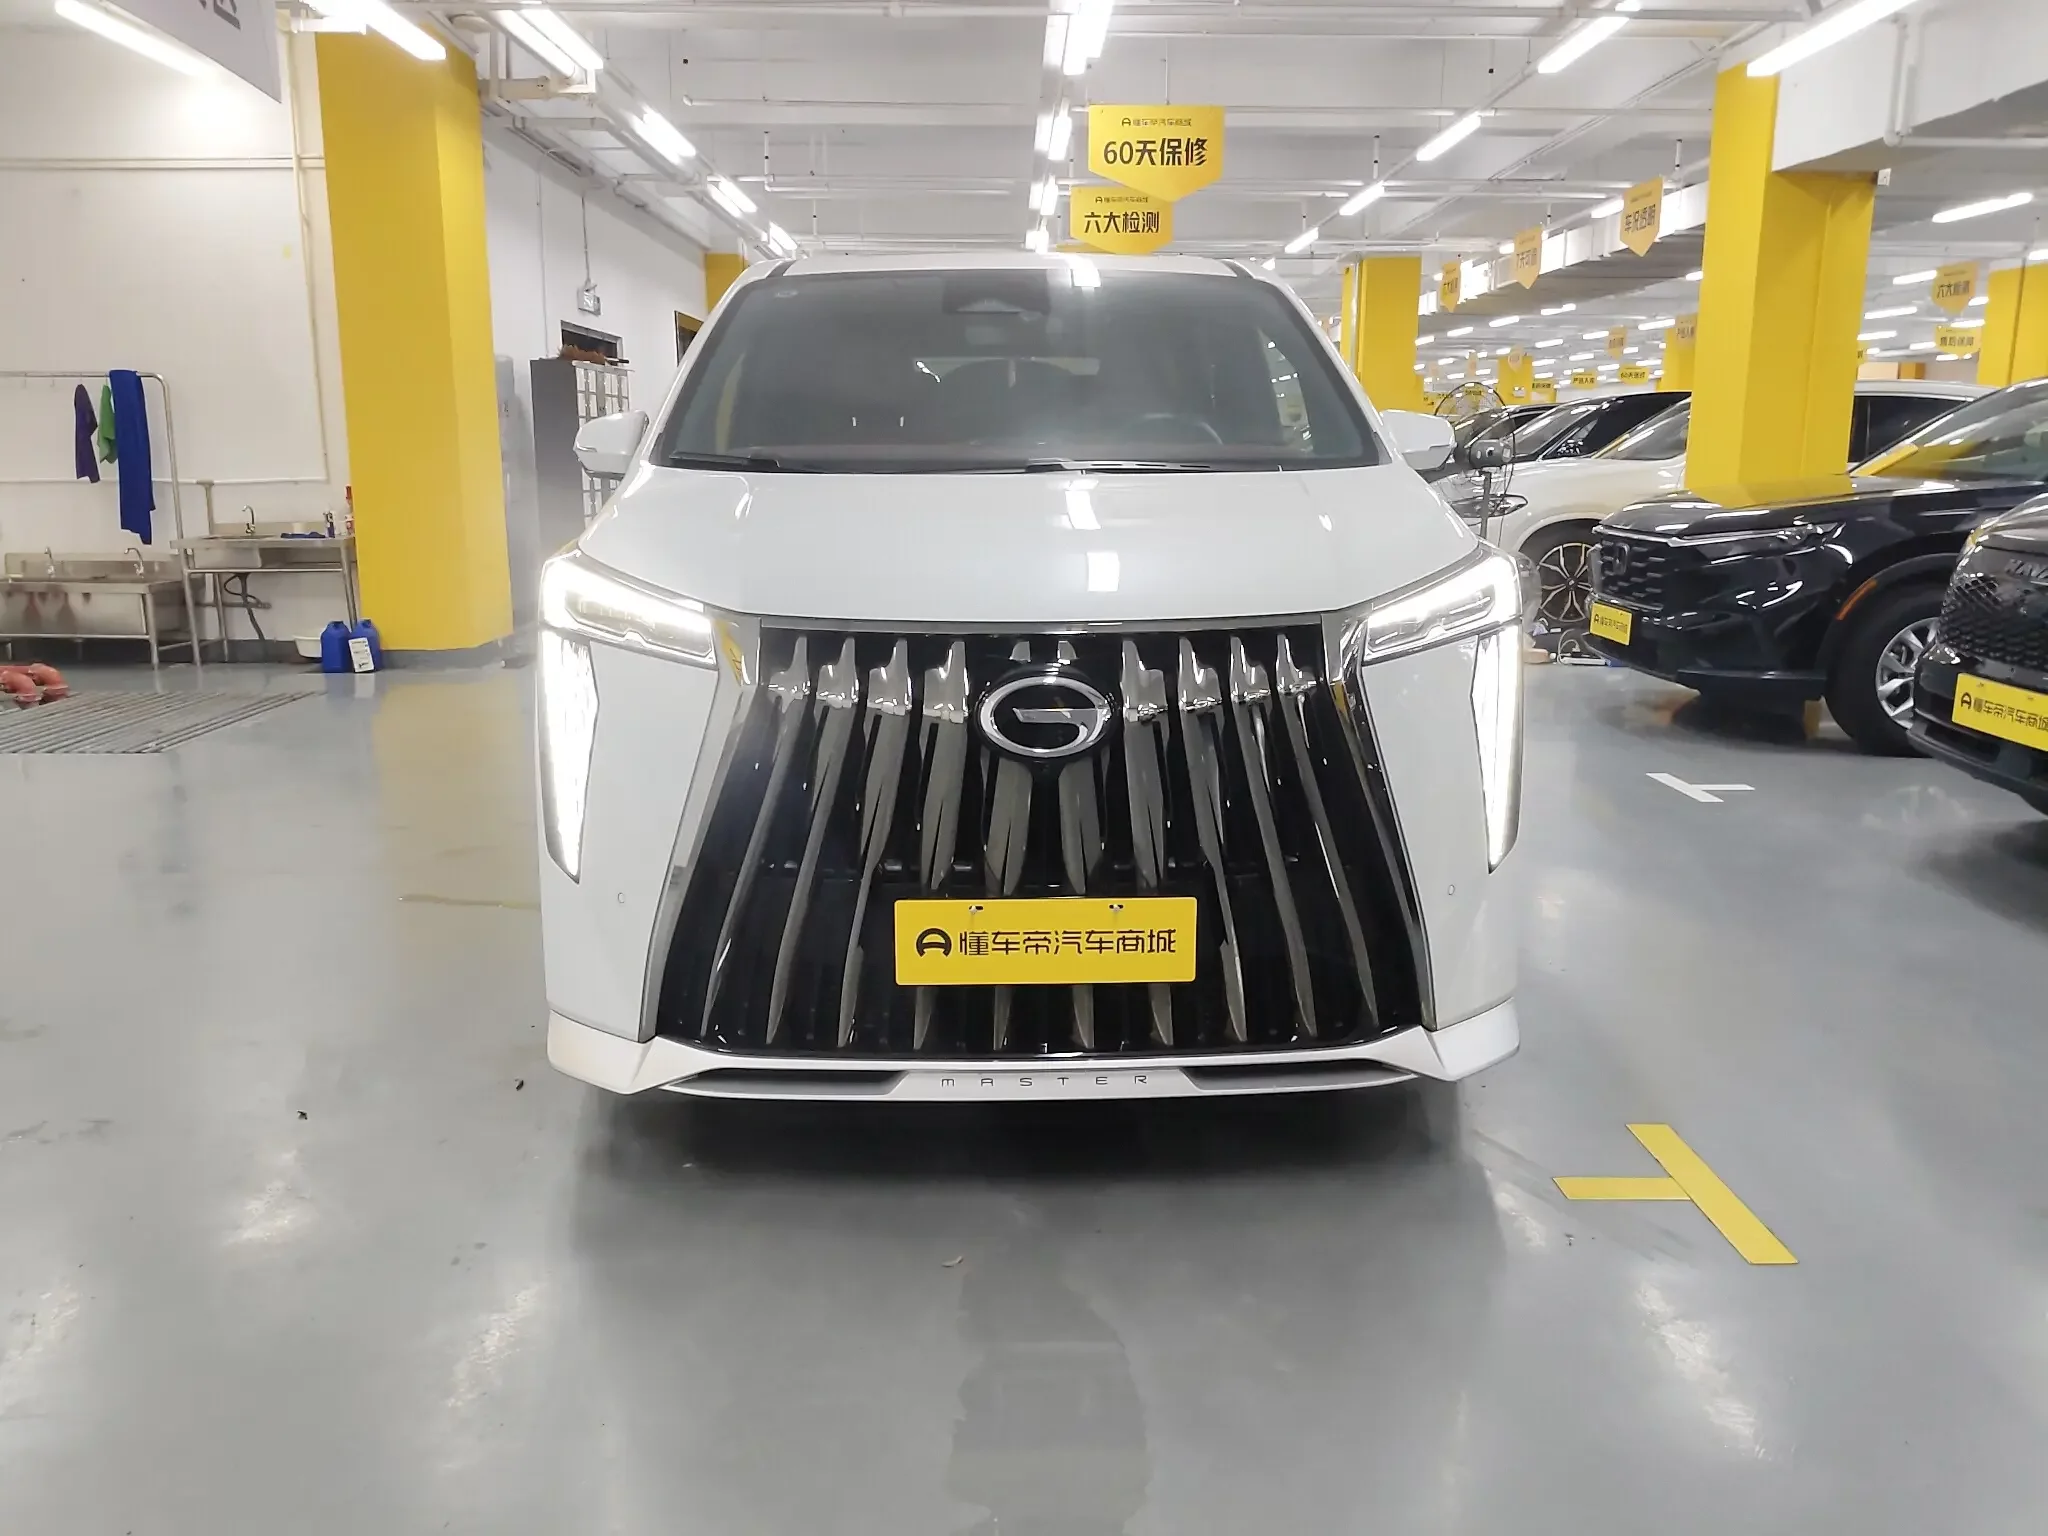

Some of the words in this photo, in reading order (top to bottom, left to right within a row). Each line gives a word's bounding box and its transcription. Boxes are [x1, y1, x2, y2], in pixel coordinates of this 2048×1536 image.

[1103, 138, 1208, 166] 60天保修
[1084, 211, 1160, 233] 六大检测
[959, 928, 1177, 956] 懂车帝汽车商城
[941, 1075, 1147, 1087] MASTER
